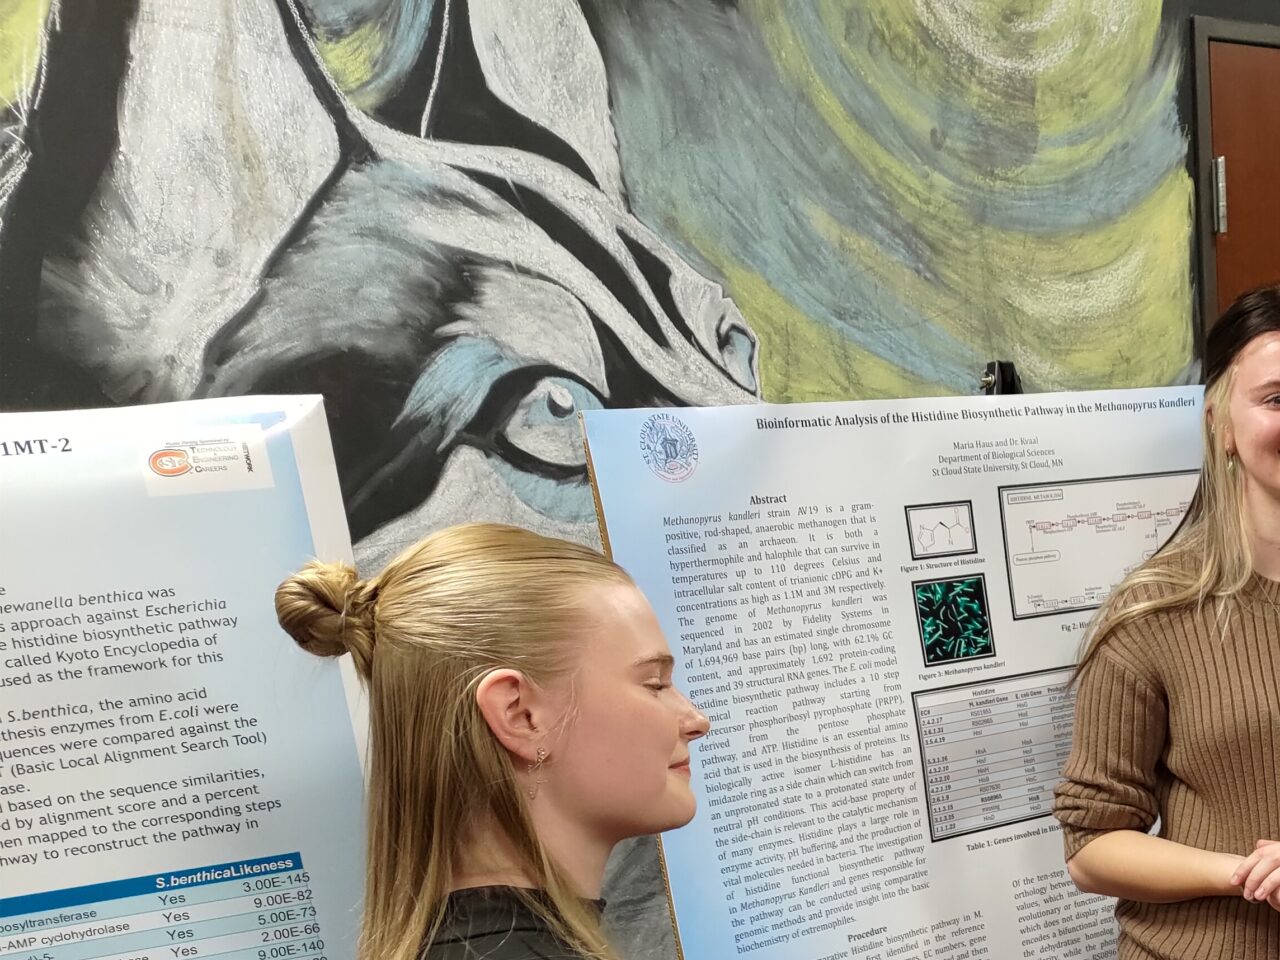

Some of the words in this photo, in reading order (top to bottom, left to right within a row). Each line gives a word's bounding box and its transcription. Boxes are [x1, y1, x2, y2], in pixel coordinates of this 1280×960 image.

[757, 415, 832, 429] Bioinformatic
[834, 413, 878, 427] Analysis
[881, 413, 891, 424] of
[892, 412, 909, 423] the
[912, 410, 959, 422] Histidine
[962, 405, 1022, 421] Biosynthetic
[1024, 403, 1064, 417] Pathway
[1066, 405, 1076, 414] in
[1078, 404, 1092, 413] the
[1095, 399, 1157, 412] Methanopyrus
[1159, 397, 1195, 408] Kandleri
[953, 442, 974, 450] Maria
[976, 438, 994, 448] Haus
[995, 438, 1008, 447] and
[1021, 436, 1039, 445] Kvaal
[938, 453, 982, 466] Department
[983, 452, 990, 460] of
[992, 450, 1025, 460] Biological
[1027, 449, 1055, 457] Sciences
[933, 468, 939, 476] St
[941, 467, 963, 476] Cloud
[964, 464, 981, 473] State
[983, 462, 1020, 473] University,
[1021, 461, 1028, 469] St
[749, 494, 787, 506] Abstract
[901, 565, 919, 573] Figure
[926, 562, 952, 570] Structure
[5, 654, 51, 669] called
[57, 649, 99, 665] Kyoto
[104, 638, 200, 658] Encyclopedia
[204, 634, 218, 646] of
[918, 673, 937, 681] Figure
[945, 665, 982, 677] Methanopyrus
[984, 661, 1006, 670] kandleri
[967, 842, 985, 851] Table
[994, 837, 1013, 846] Genes
[1014, 830, 1040, 841] involved
[155, 859, 294, 889] S.benthicaLikeness
[159, 893, 186, 906] Yes
[243, 872, 310, 893] 3.00E-145
[162, 911, 190, 923] Yes
[254, 890, 313, 908] 9.00E-82
[847, 925, 888, 942] Procedure
